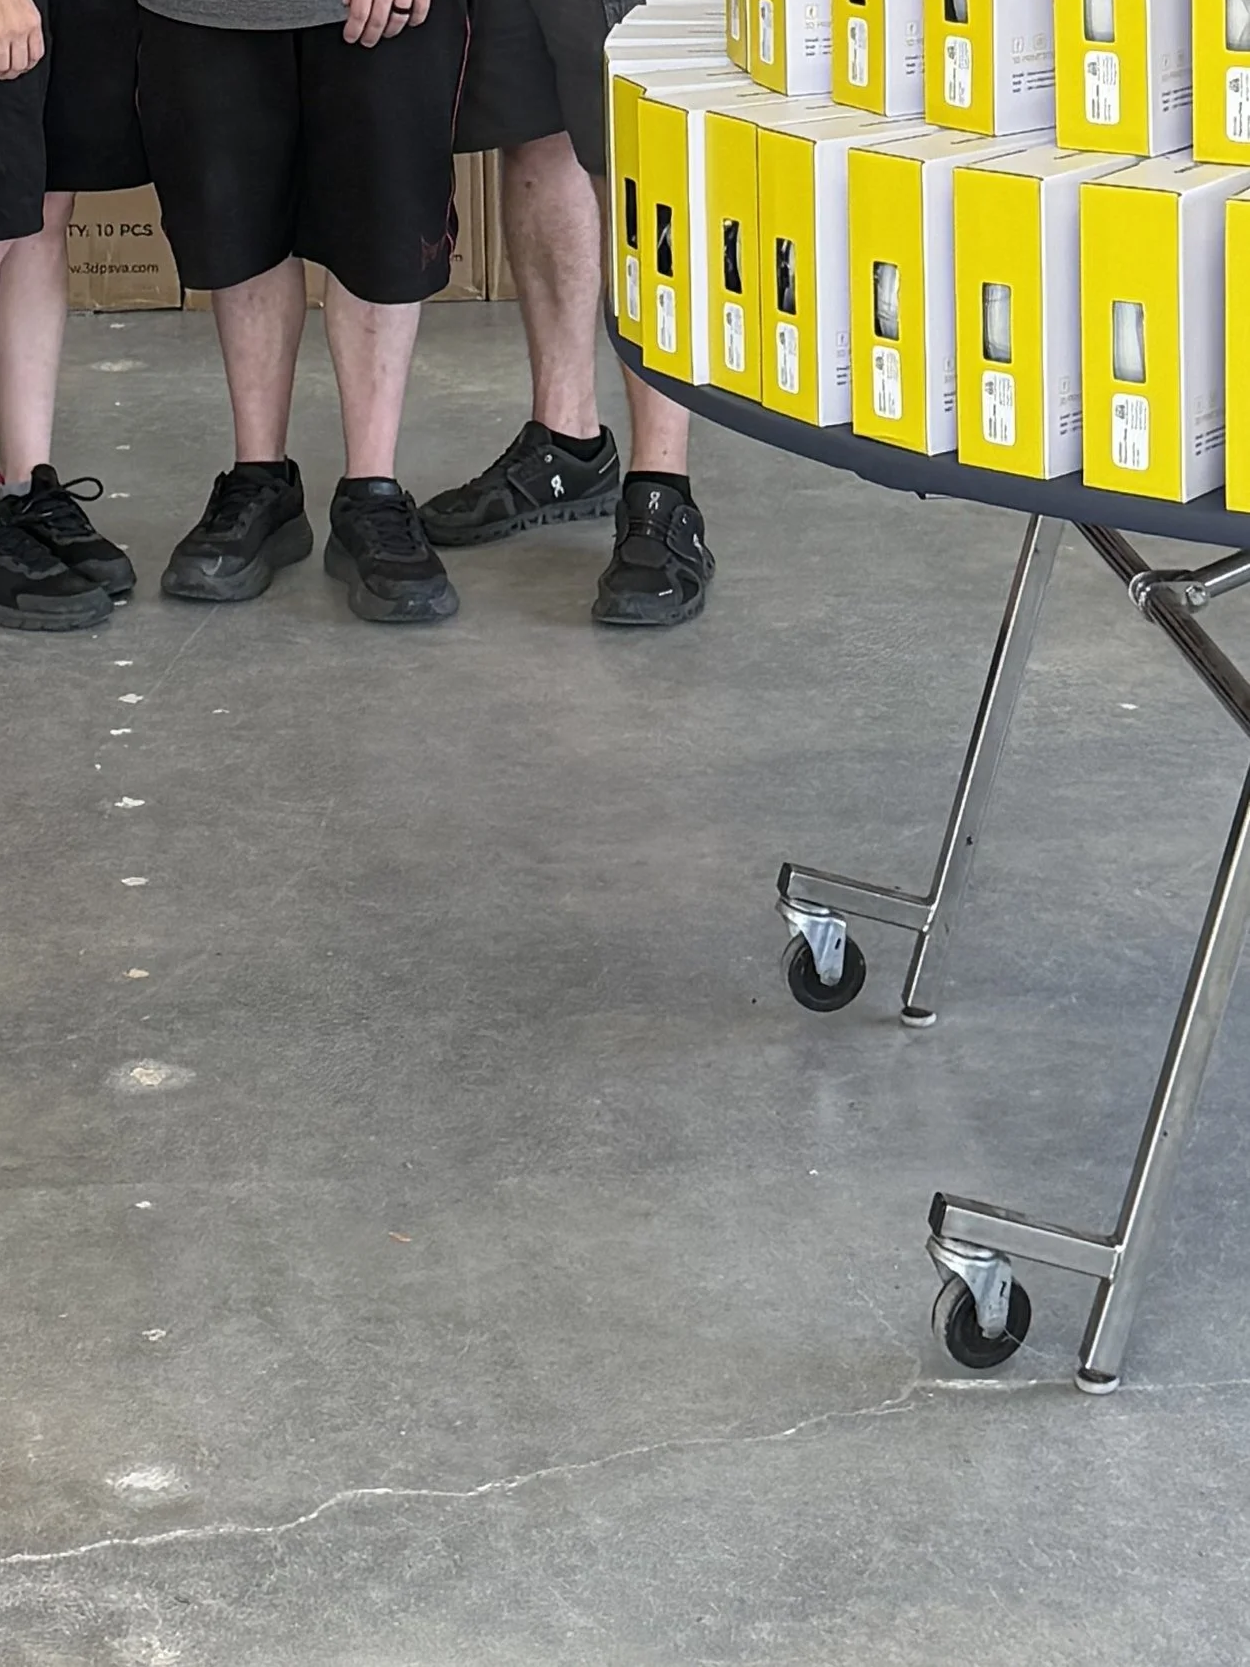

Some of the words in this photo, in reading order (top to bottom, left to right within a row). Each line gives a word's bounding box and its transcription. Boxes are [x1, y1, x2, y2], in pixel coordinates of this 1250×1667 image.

[68, 223, 90, 238] TY:
[97, 223, 114, 238] 10
[120, 223, 154, 238] PCS
[69, 261, 159, 276] w.3dpsva.com
